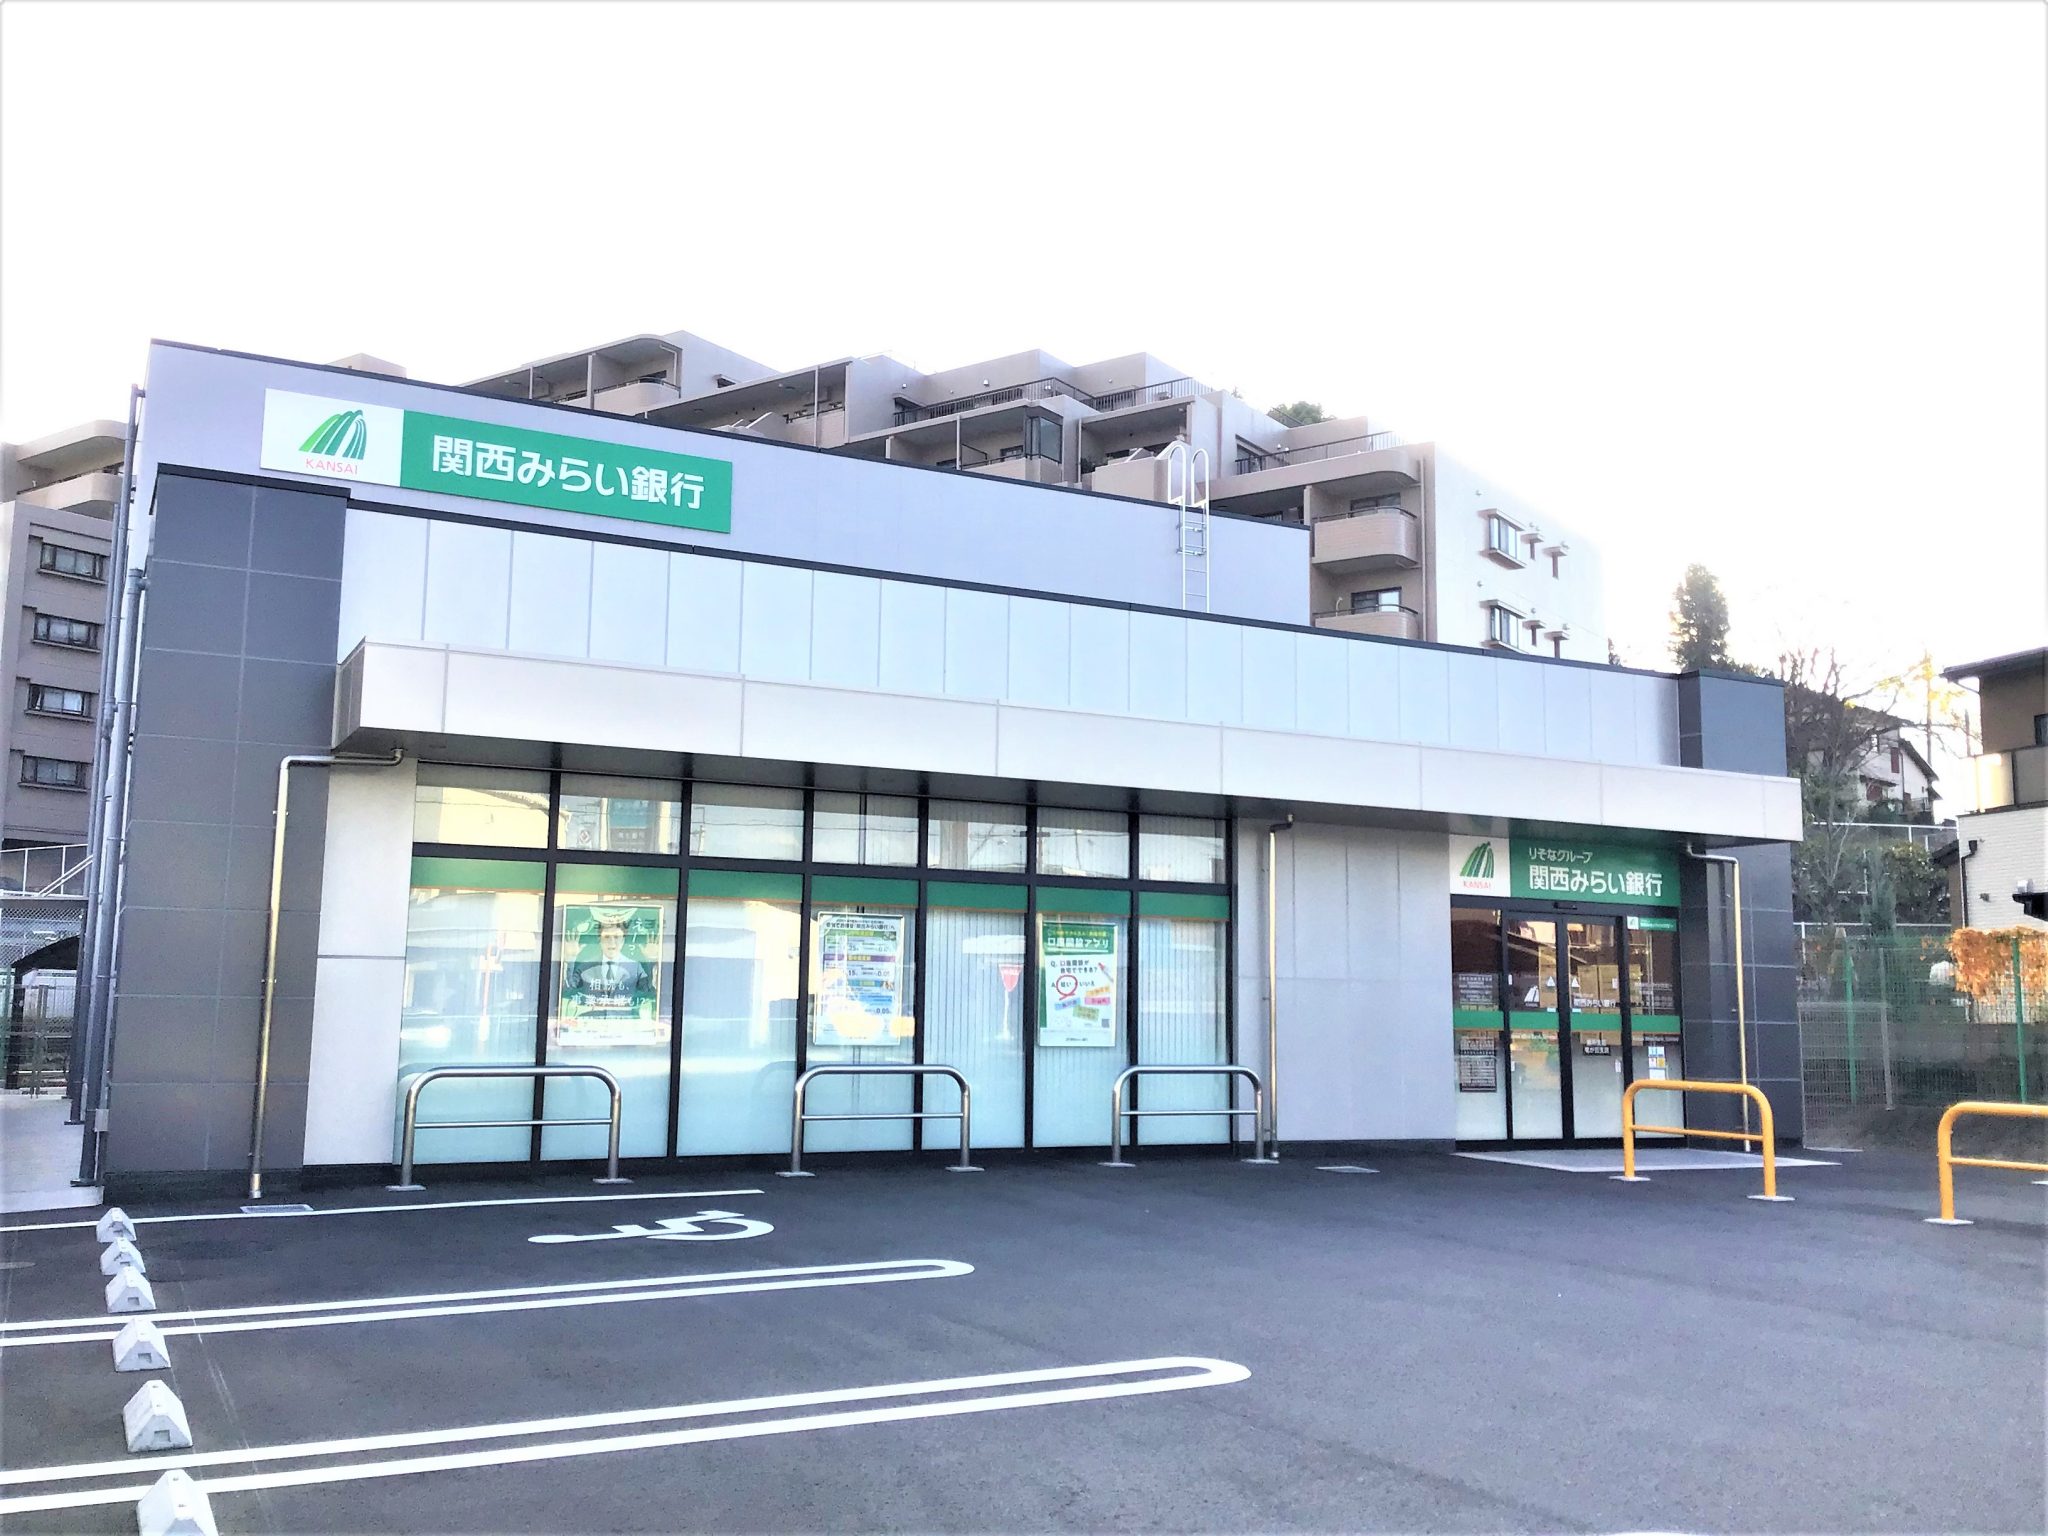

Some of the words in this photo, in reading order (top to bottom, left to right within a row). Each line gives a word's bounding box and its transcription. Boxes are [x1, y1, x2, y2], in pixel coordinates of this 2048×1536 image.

[305, 458, 358, 475] KANSAI
[432, 434, 705, 510] 関西みらい銀行
[1528, 847, 1593, 863] りそなグループ
[1463, 880, 1492, 890] KANSAI
[1529, 864, 1663, 897] 関西みらい銀行
